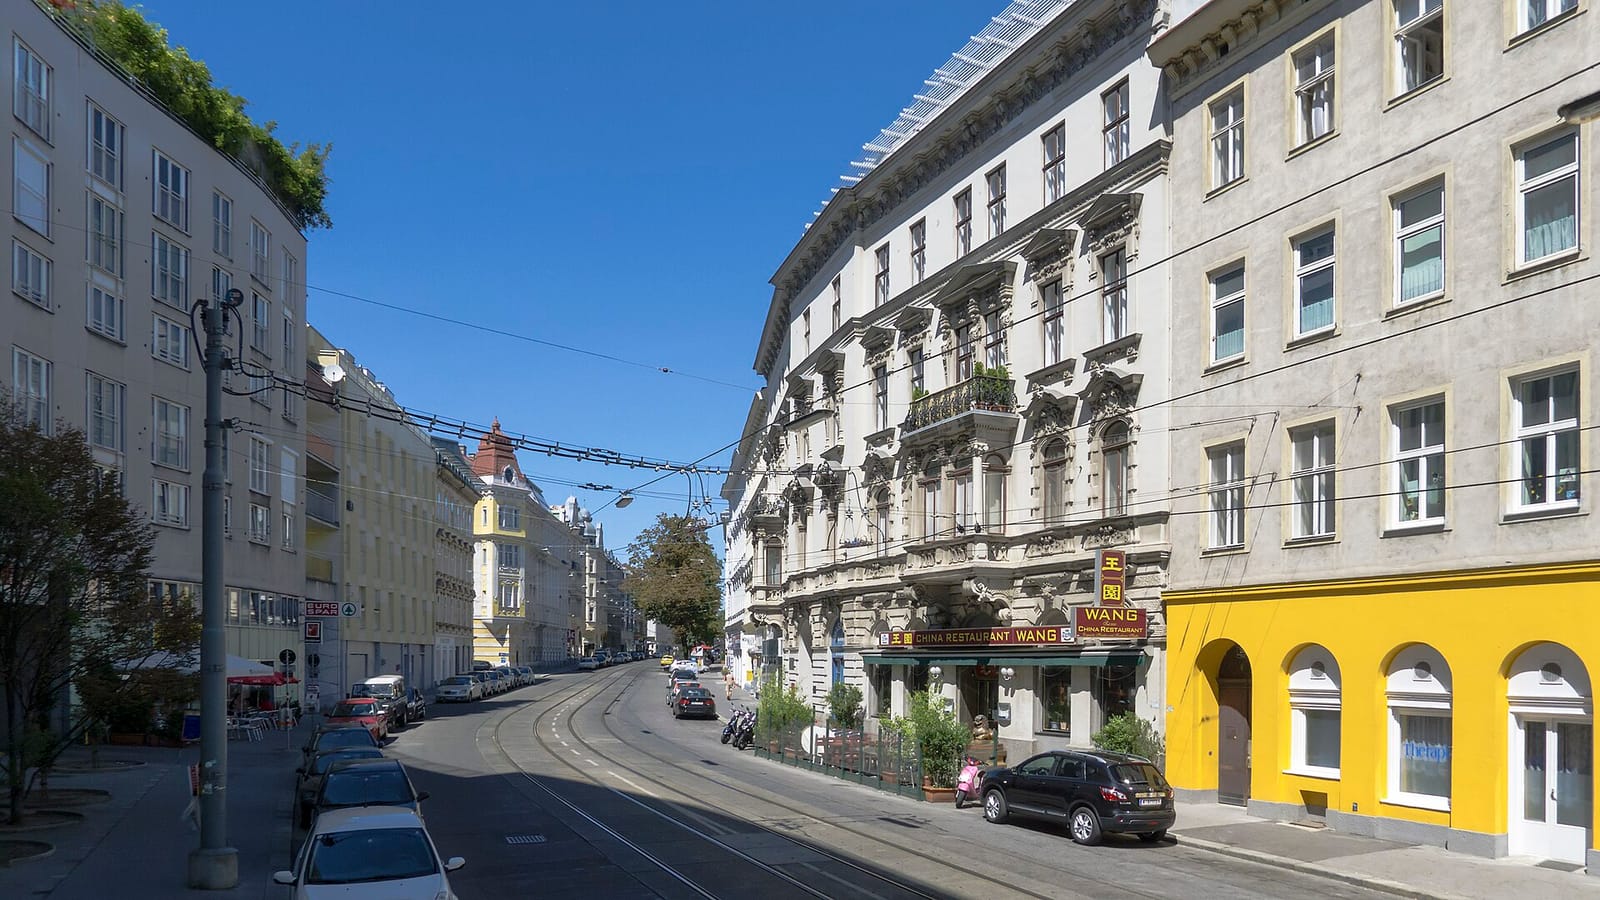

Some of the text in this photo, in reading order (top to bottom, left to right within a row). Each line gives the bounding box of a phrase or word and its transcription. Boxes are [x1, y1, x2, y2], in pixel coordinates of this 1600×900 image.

[1085, 608, 1138, 621] WANG
[1078, 625, 1100, 633] CHINA
[916, 634, 943, 643] CHINA
[945, 631, 1010, 642] RESTAURANT
[1016, 629, 1057, 642] WANG
